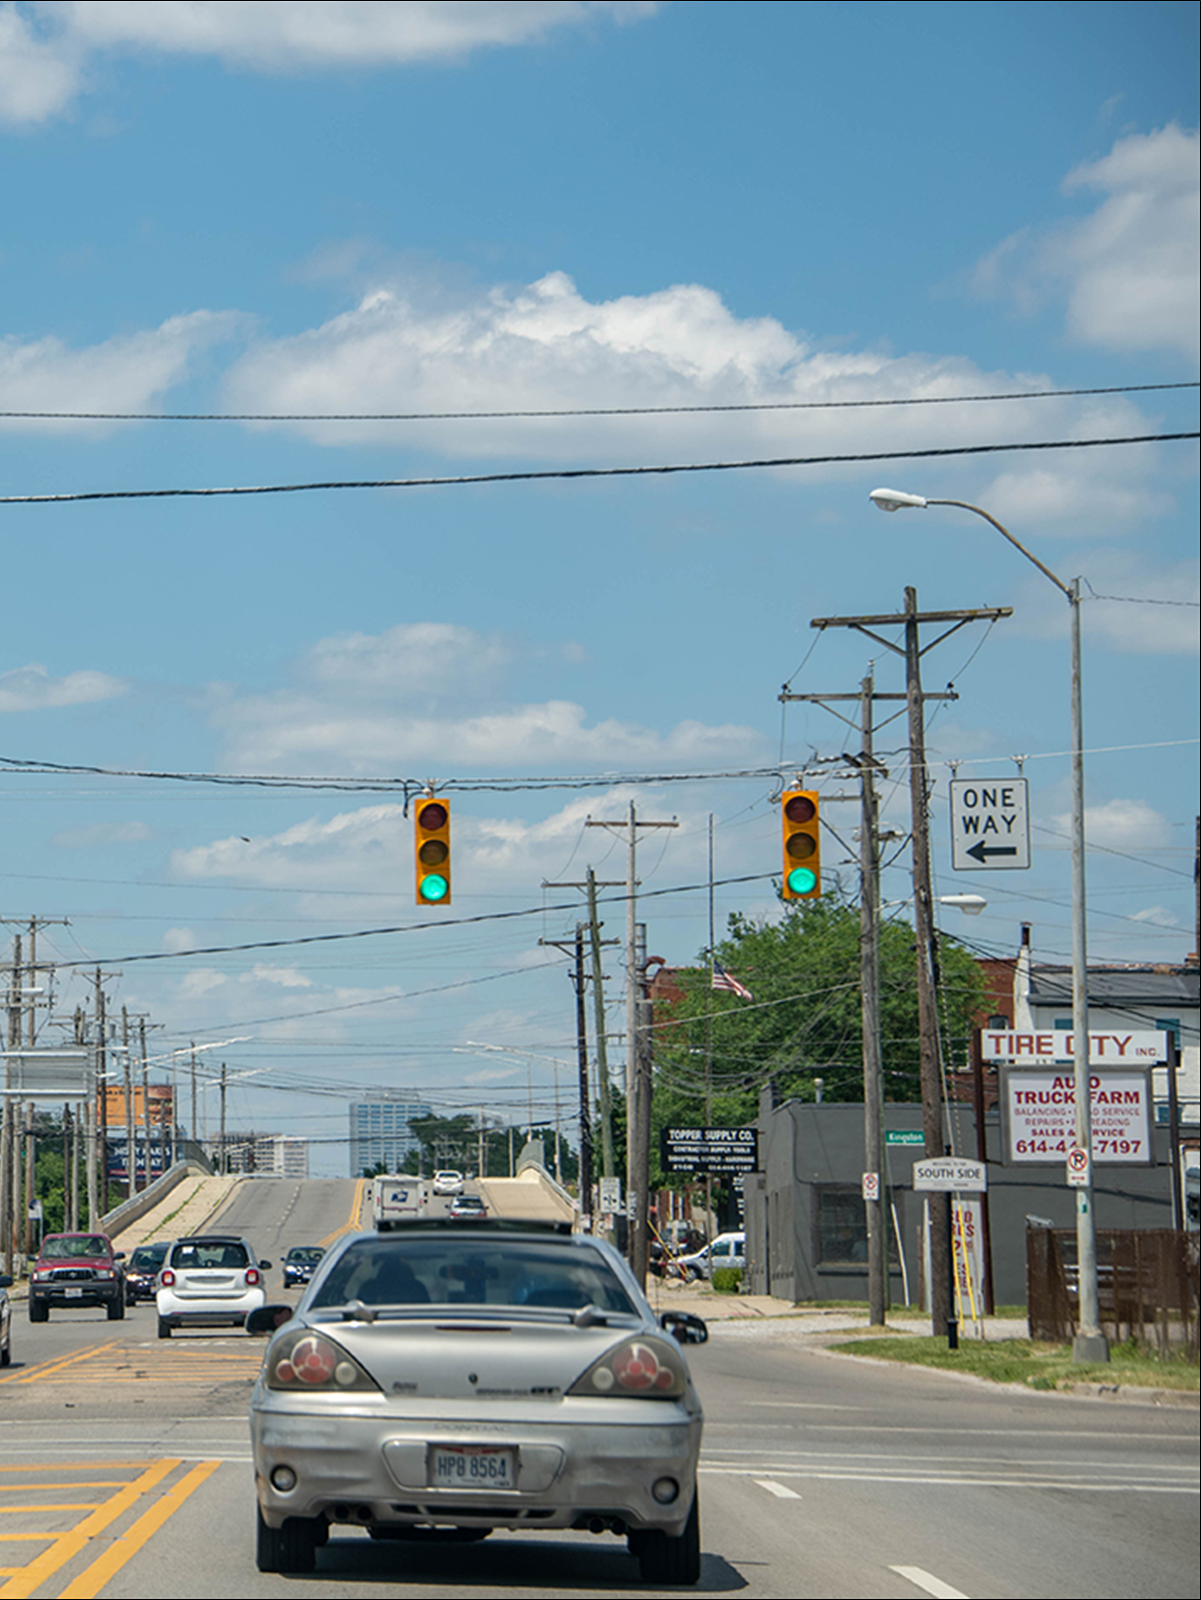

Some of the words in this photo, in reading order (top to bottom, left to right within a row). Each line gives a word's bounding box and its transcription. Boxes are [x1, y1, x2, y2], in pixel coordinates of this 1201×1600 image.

[963, 788, 1016, 808] ONE
[962, 814, 1017, 834] WAY
[987, 1034, 1054, 1055] TIRE
[1065, 1035, 1133, 1056] CTY
[1052, 1076, 1101, 1090] AUO
[1014, 1091, 1076, 1105] TRUCK
[1089, 1091, 1140, 1105] FARM
[1014, 1108, 1067, 1117] BALANCING
[1102, 1108, 1141, 1117] SERVICE
[1025, 1118, 1065, 1126] REPAIRS
[669, 1130, 702, 1140] TOPPER
[704, 1130, 737, 1140] SUPPLY
[888, 1132, 923, 1143] Kingston
[1031, 1129, 1065, 1137] SALES
[1092, 1129, 1125, 1137] RVICE
[1016, 1139, 1142, 1154] 614-4-7197
[917, 1168, 954, 1179] SOUTH
[956, 1168, 982, 1179] SIDE
[469, 1456, 506, 1478] 8564
